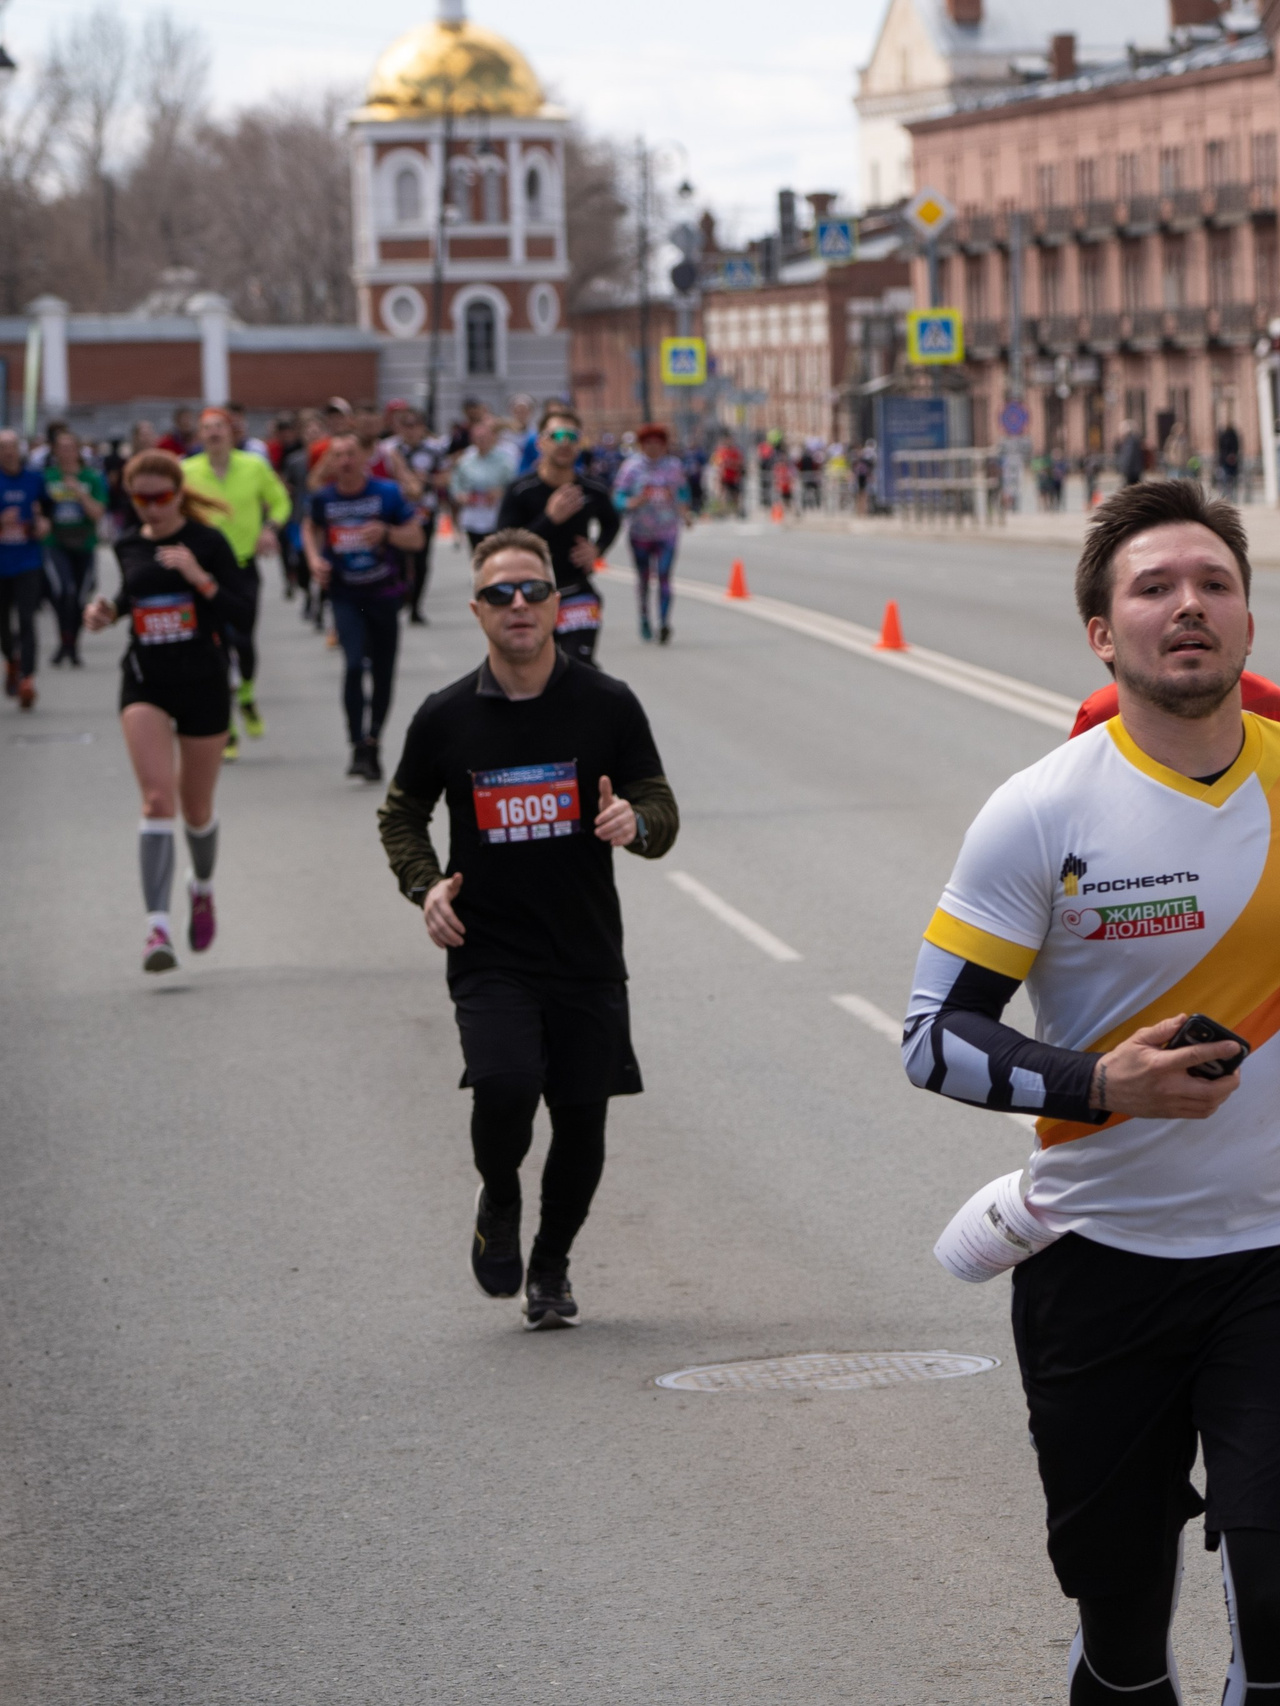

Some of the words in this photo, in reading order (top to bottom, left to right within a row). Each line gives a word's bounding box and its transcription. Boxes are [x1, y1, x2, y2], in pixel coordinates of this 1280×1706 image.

[496, 793, 558, 826] 1609
[1082, 871, 1200, 895] РОСНЕФТЬ
[1105, 899, 1193, 923] ЖИВИТЕ
[1104, 913, 1200, 940] ДОЛЬШЕ!
